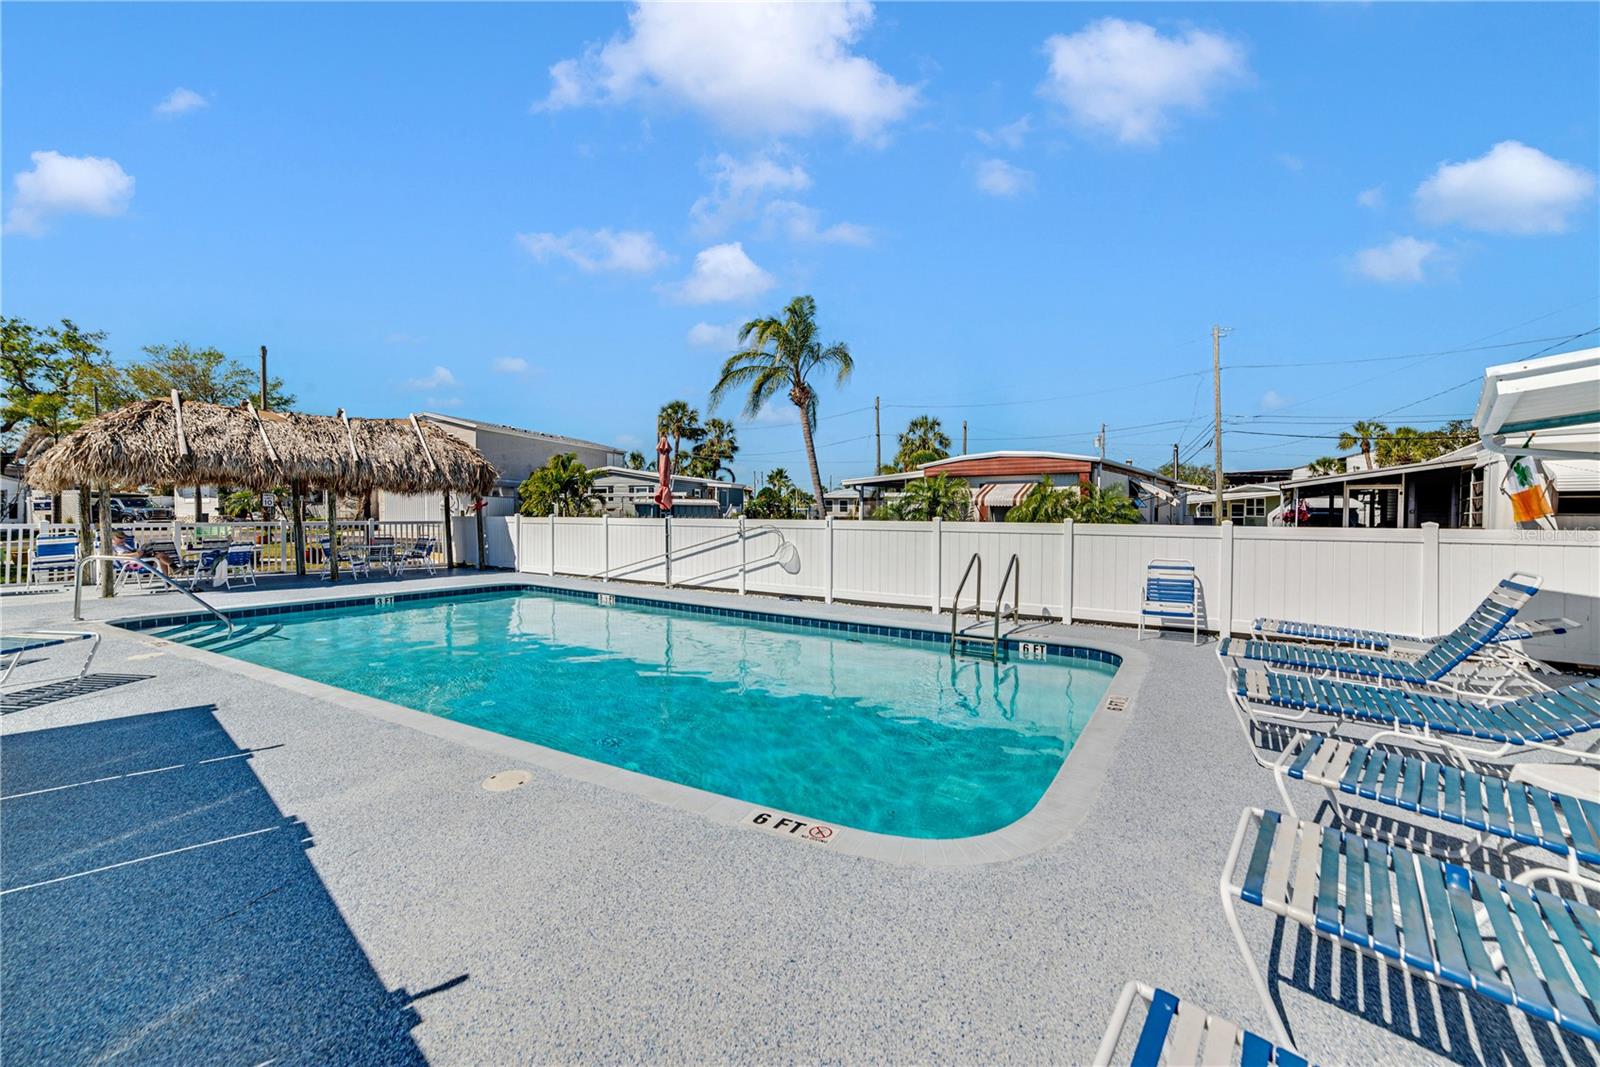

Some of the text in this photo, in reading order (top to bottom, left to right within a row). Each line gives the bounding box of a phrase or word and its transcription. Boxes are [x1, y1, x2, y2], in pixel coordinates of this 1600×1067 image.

[1022, 643, 1046, 654] 6 FT
[752, 812, 807, 834] 6 FT
